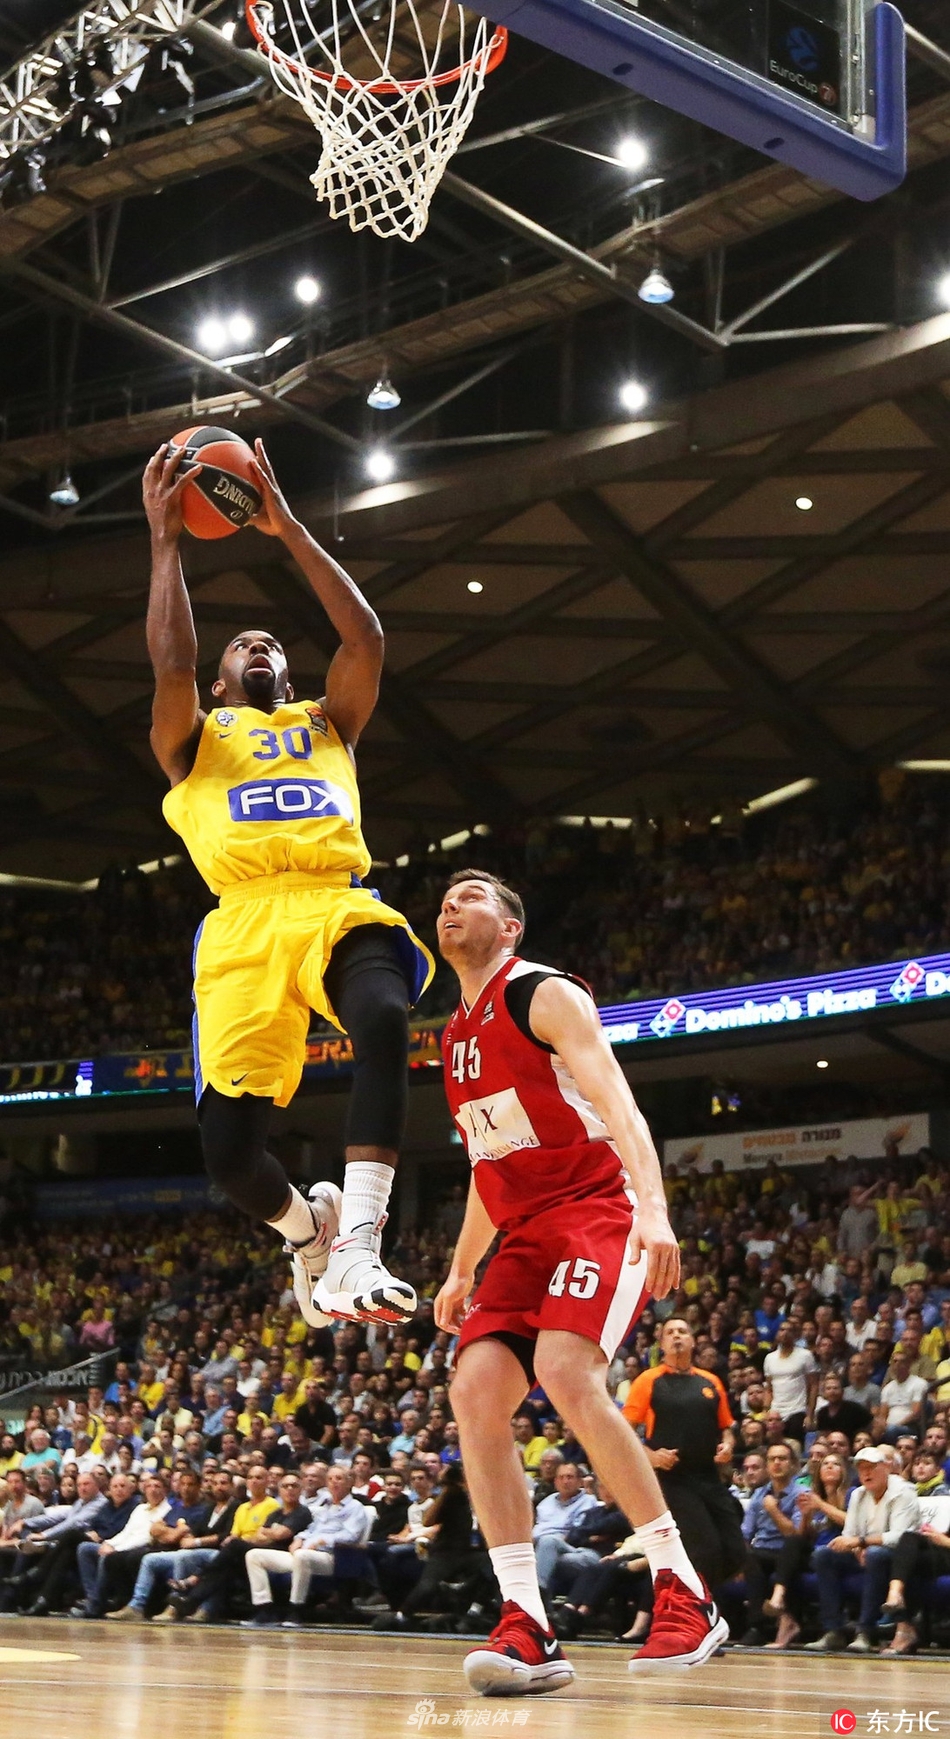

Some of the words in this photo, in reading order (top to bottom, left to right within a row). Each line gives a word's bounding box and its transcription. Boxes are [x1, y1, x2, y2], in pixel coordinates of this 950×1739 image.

[769, 60, 818, 96] EuroCup
[248, 726, 313, 761] 30
[240, 784, 344, 815] FOX
[685, 994, 803, 1034] Domino's
[807, 988, 877, 1018] Pizza
[451, 1036, 482, 1085] 45
[547, 1257, 601, 1300] 45
